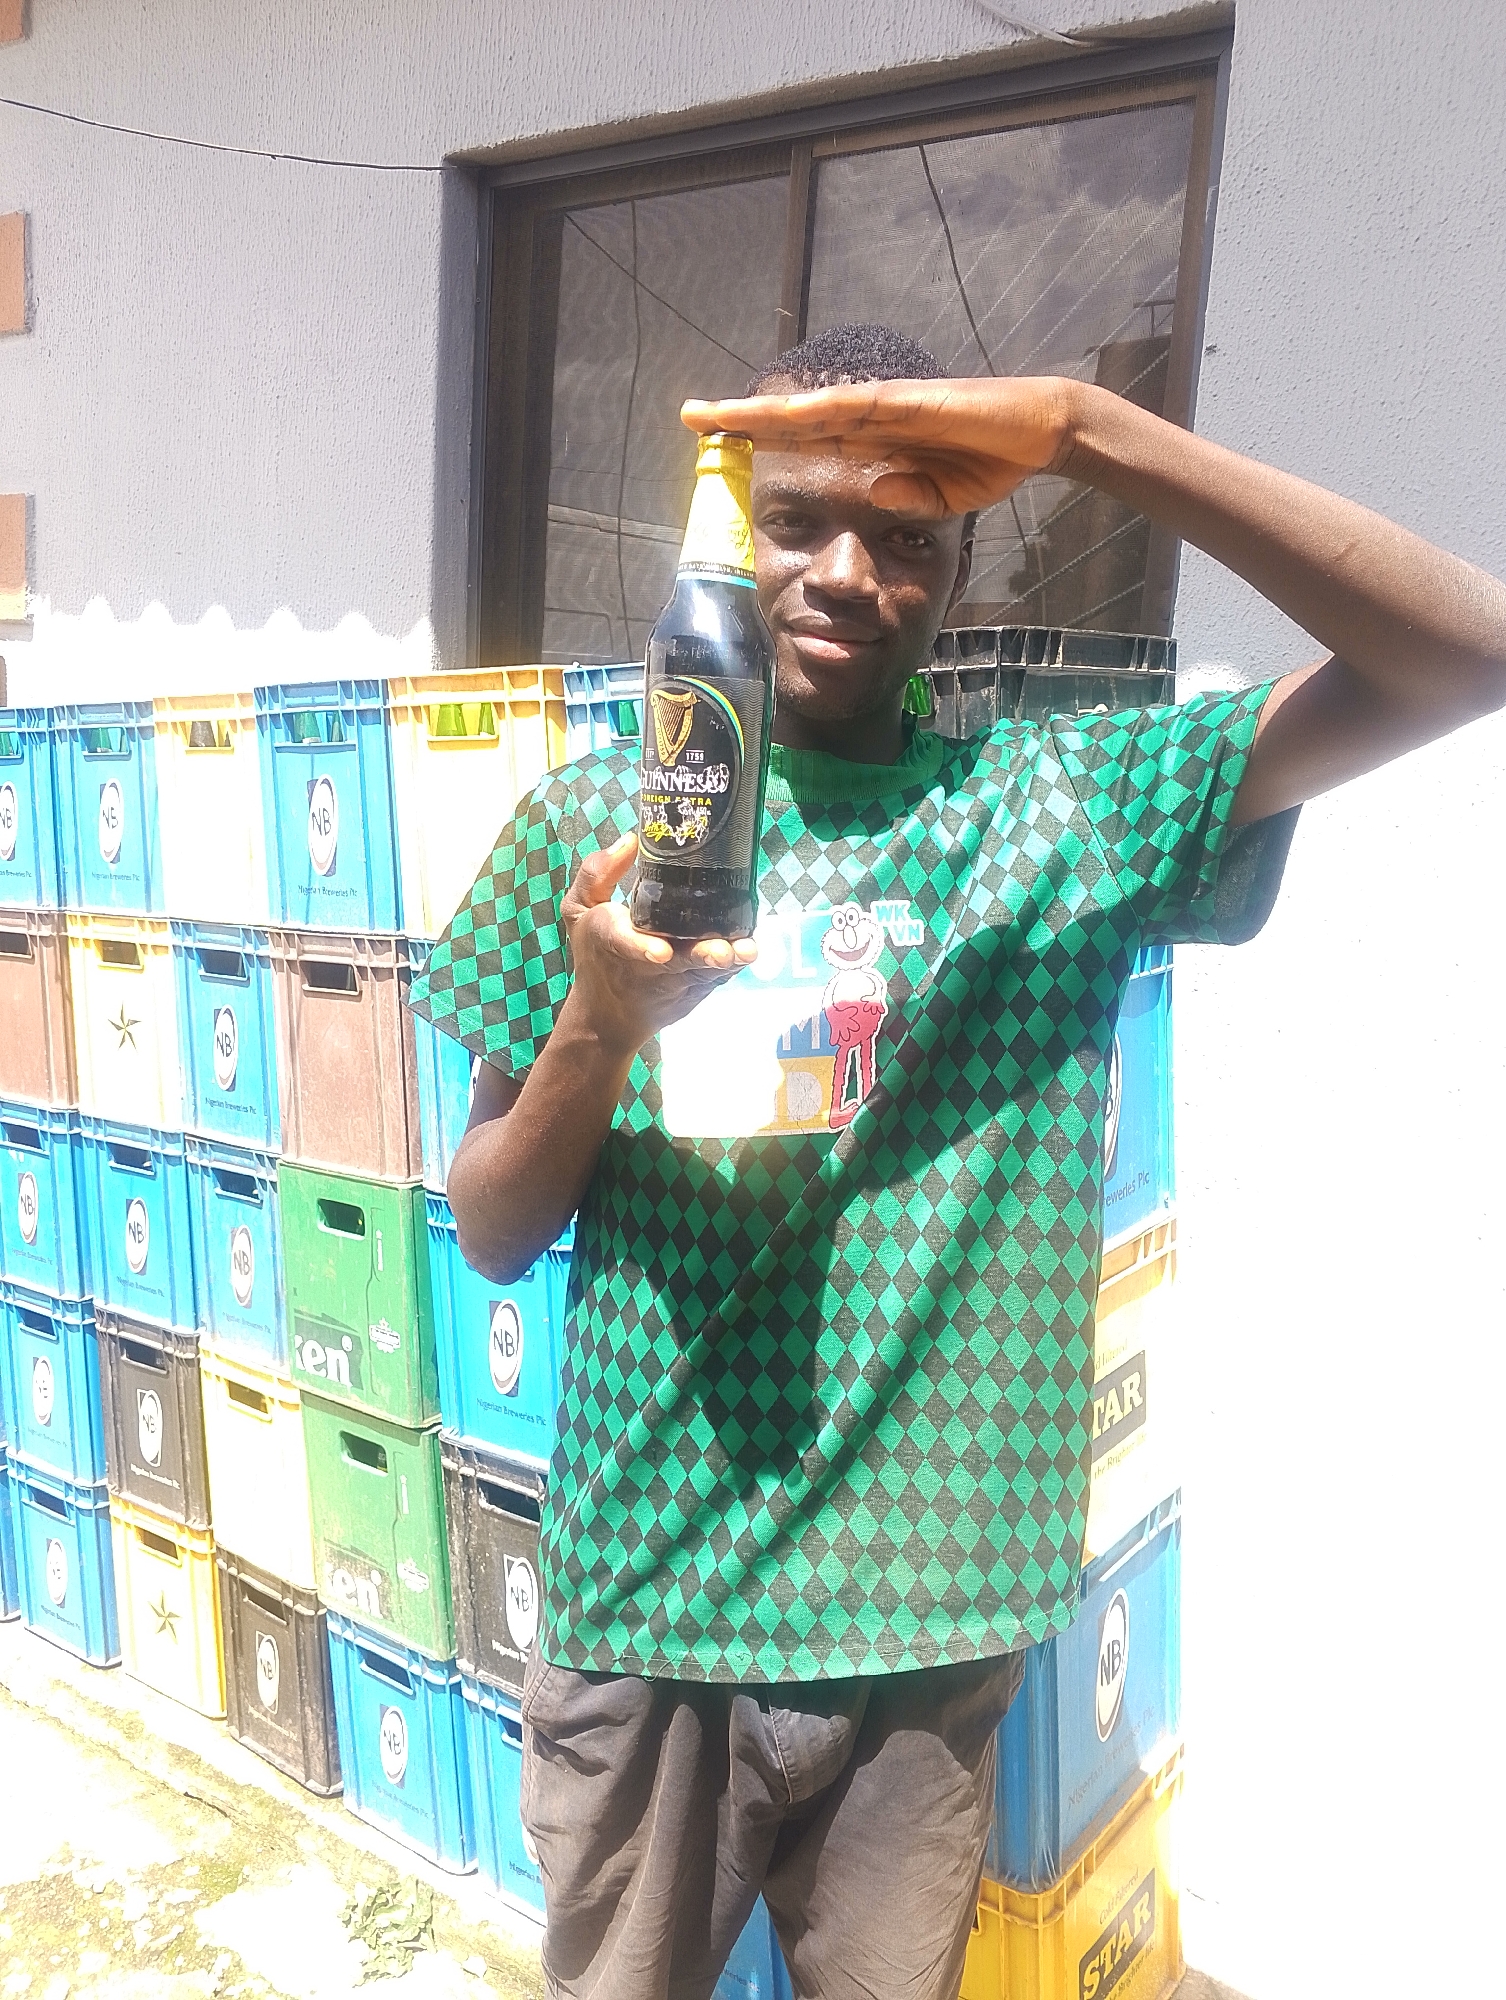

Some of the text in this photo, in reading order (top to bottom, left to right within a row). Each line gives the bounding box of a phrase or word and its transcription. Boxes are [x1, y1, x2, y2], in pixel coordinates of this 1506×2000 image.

[311, 807, 332, 836] NB
[876, 904, 907, 923] WK
[216, 1031, 233, 1058] NB
[1137, 1170, 1150, 1190] Plc
[128, 1220, 145, 1245] NB
[233, 1249, 251, 1276] NB
[493, 1328, 516, 1358] NB
[1092, 1371, 1144, 1441] TAR
[511, 1585, 530, 1613] NB
[1101, 1639, 1121, 1687] NB
[1083, 1891, 1152, 2000] STAR
